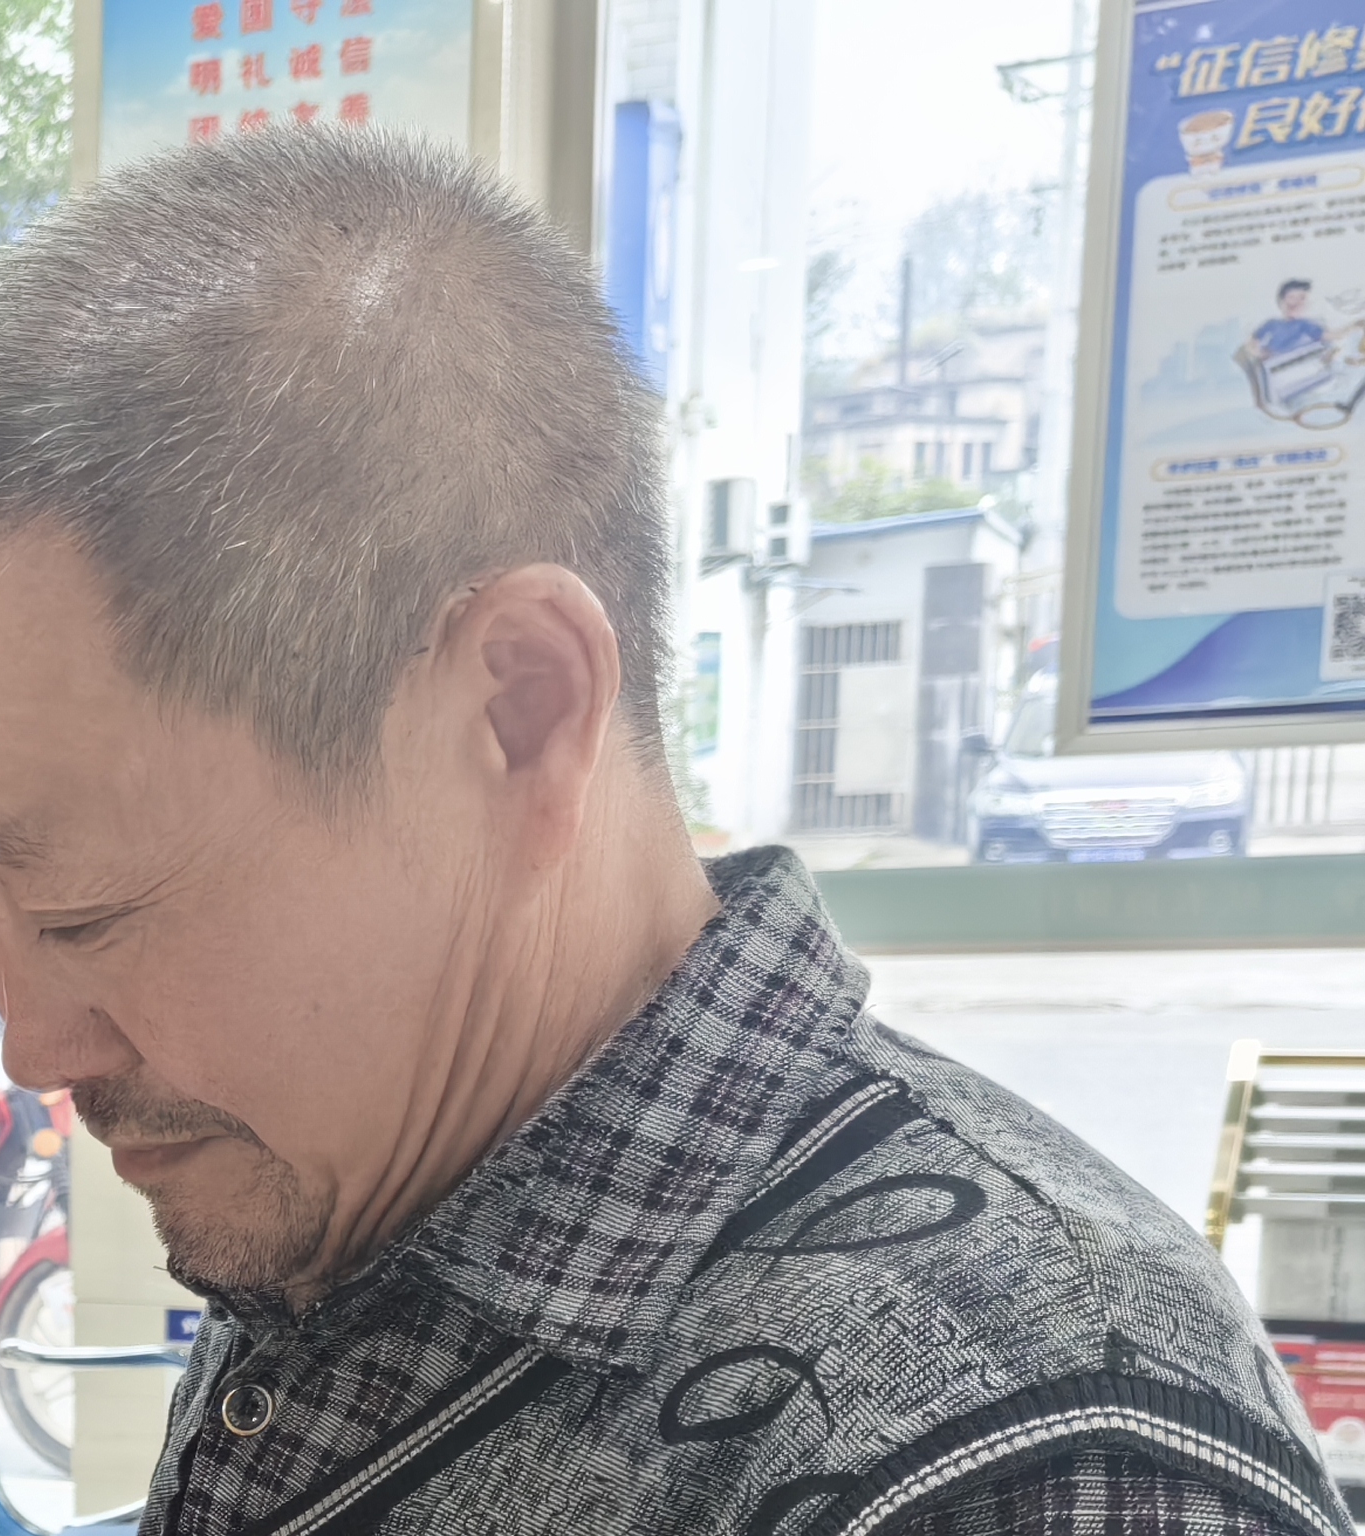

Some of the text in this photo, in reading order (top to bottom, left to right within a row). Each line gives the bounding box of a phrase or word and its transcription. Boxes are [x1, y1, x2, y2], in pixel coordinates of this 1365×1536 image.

[190, 36, 373, 95] 明礼诚信
[1155, 20, 1365, 97] “征信修
[1236, 87, 1365, 149] 良好
